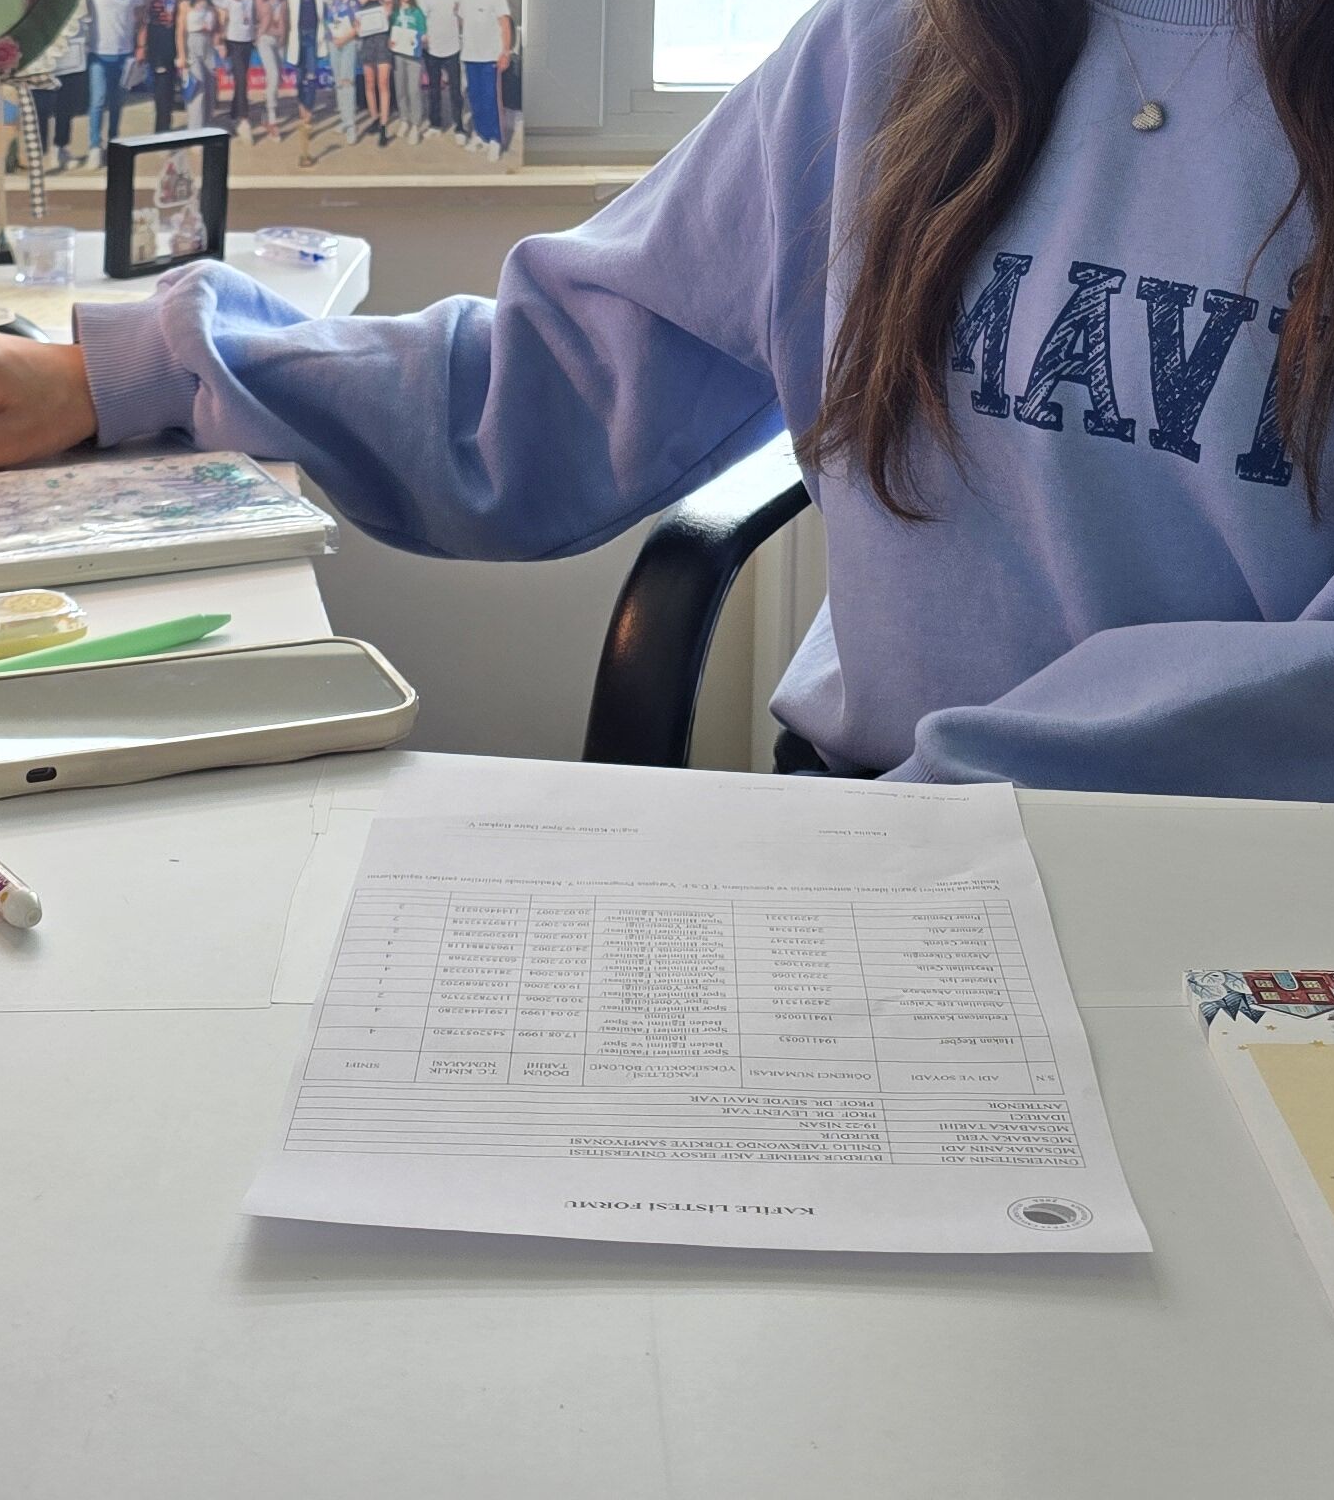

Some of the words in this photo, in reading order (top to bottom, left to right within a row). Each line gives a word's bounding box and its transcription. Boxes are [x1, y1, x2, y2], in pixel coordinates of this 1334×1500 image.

[688, 1095, 719, 1103] VAR
[721, 1107, 750, 1115] VAR
[753, 1109, 808, 1117] LEVENT
[737, 1142, 826, 1150] TAEKWONDO
[758, 1152, 819, 1161] MEHMET
[824, 1153, 883, 1161] BURDUR
[563, 1200, 642, 1211] FORMU
[648, 1202, 728, 1214] LİSTESİ
[735, 1204, 815, 1216] KAFİLE
